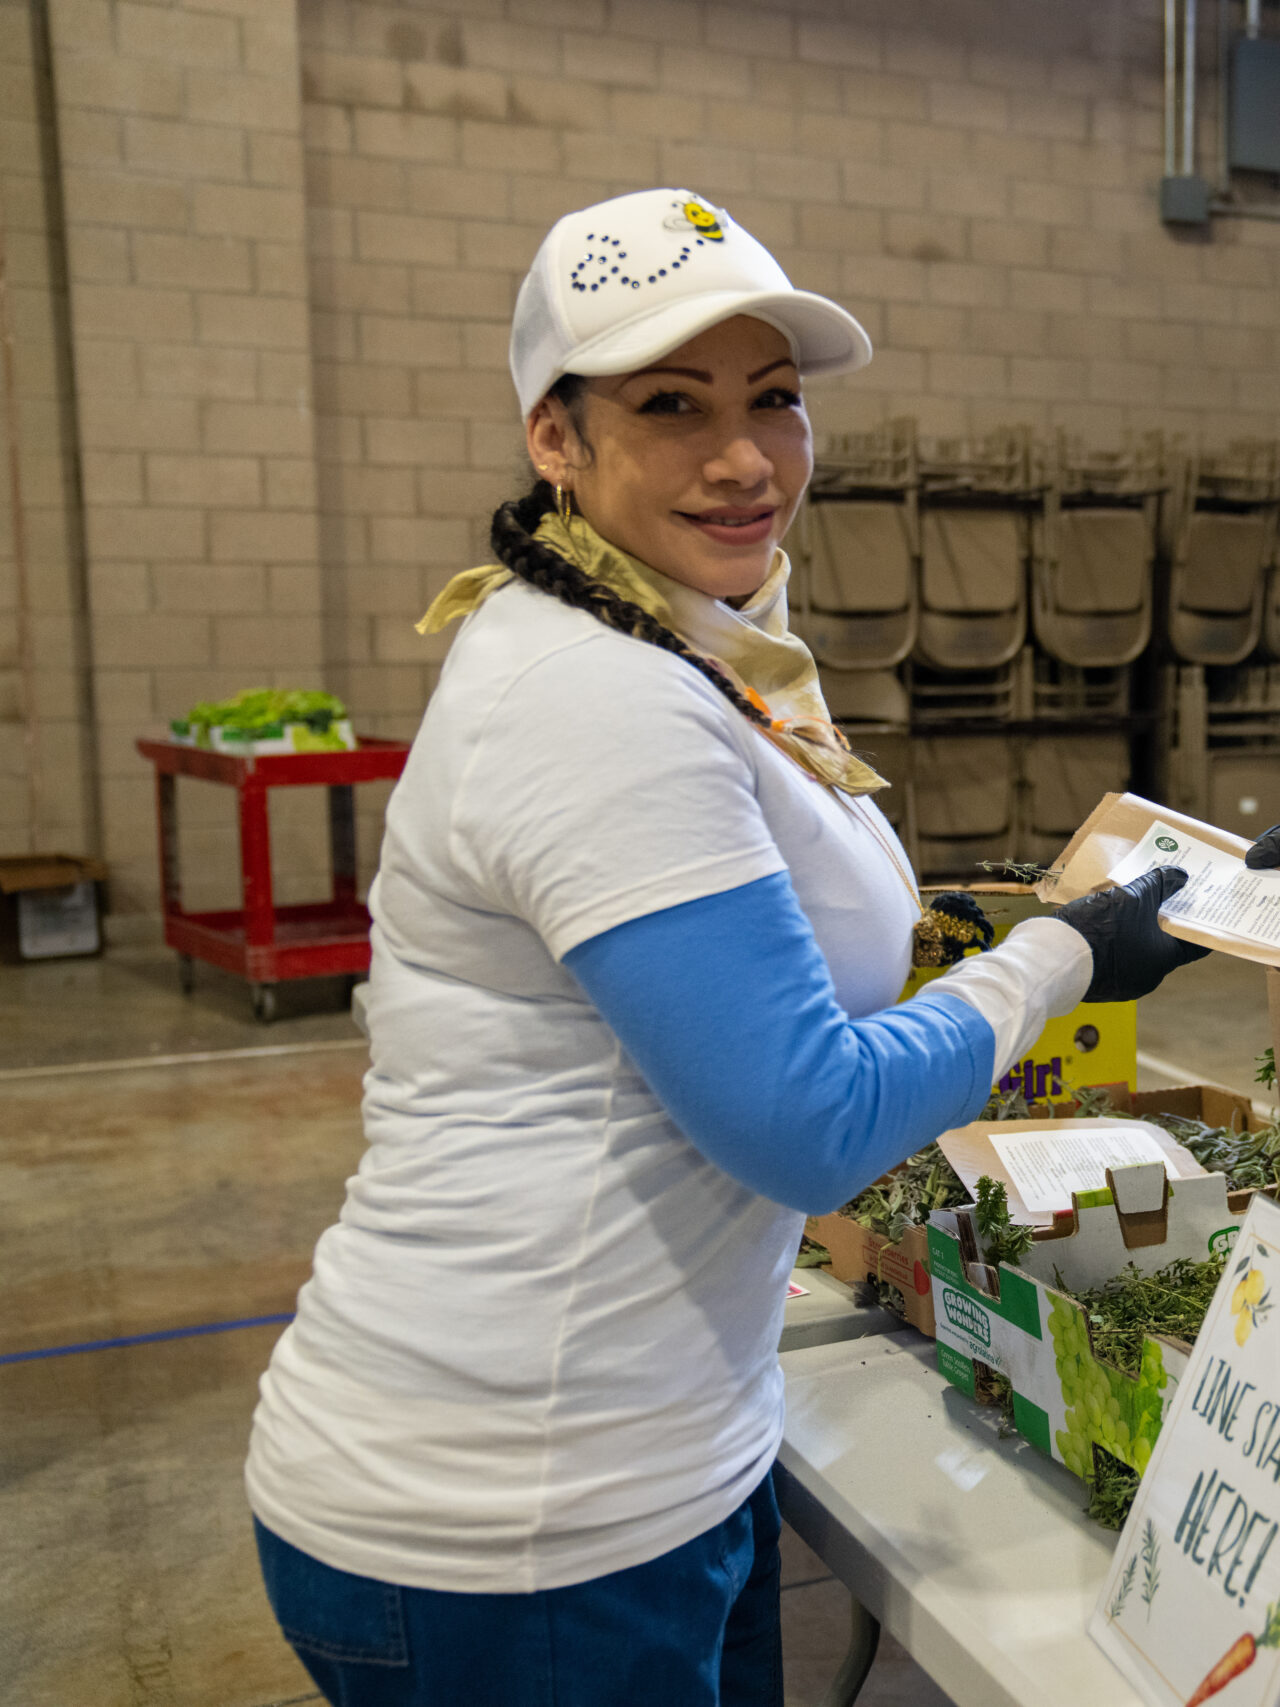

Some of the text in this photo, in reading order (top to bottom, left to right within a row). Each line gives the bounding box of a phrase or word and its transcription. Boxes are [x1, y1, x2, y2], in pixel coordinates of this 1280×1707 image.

[944, 1291, 989, 1330] GROWING
[946, 1305, 990, 1343] WONDERS
[1192, 1355, 1257, 1444] LINE
[1173, 1468, 1279, 1609] HERE!
